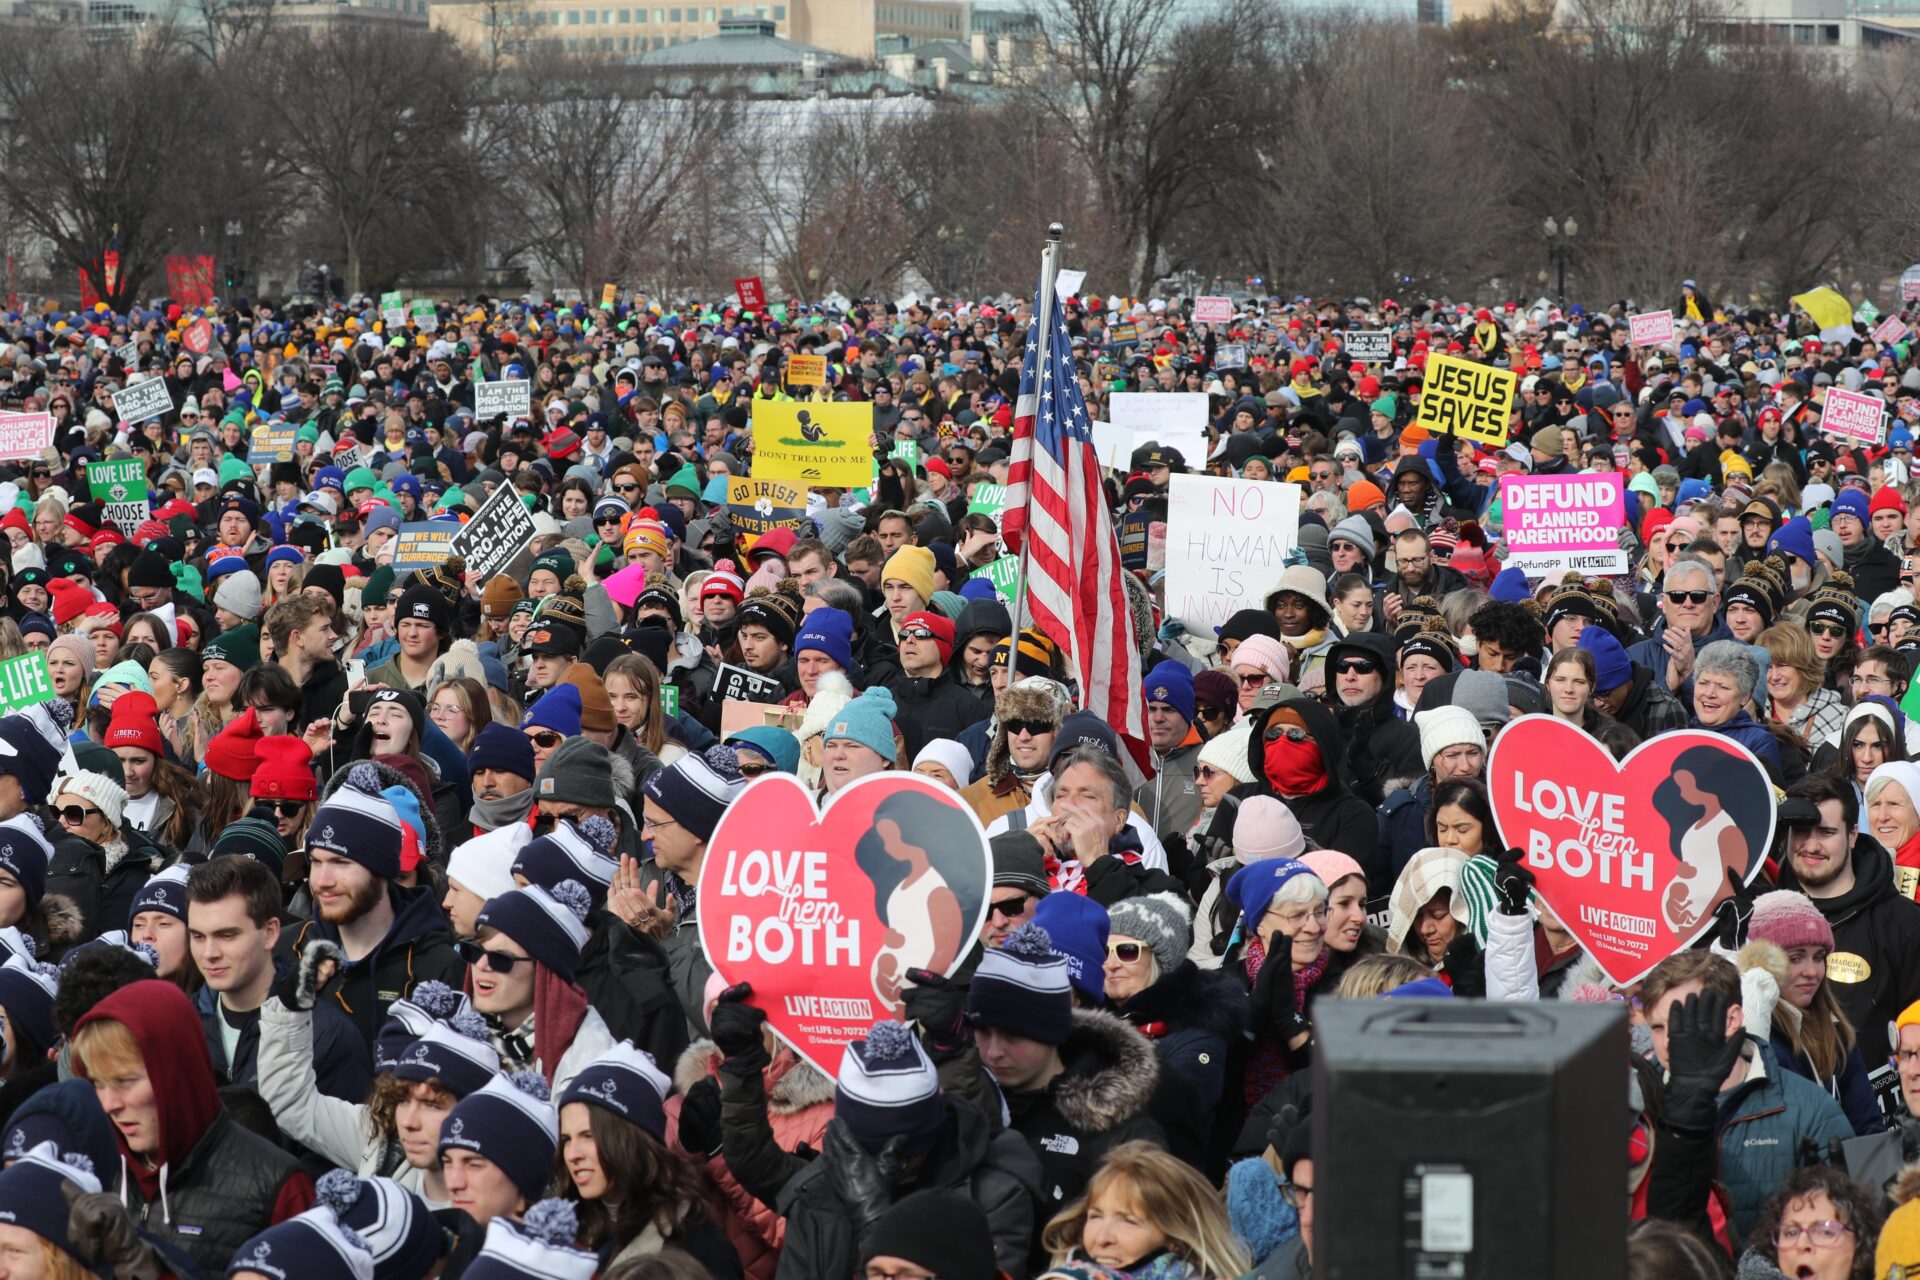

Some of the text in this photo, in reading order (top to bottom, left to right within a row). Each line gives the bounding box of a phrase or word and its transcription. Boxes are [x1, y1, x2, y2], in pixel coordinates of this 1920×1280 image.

[1633, 316, 1670, 330] DEFUND
[1347, 343, 1389, 351] PRO-LIFE
[1355, 336, 1367, 344] AM
[1370, 336, 1387, 344] THE
[125, 391, 141, 403] AM
[143, 382, 161, 395] THE
[507, 386, 526, 394] THE
[1427, 363, 1508, 407] JESUS
[116, 390, 168, 412] PRO-LIFE
[121, 400, 170, 420] GENERATION
[478, 393, 529, 407] PRO-LIFE
[478, 404, 528, 414] GENERATION
[1828, 394, 1880, 419] DEFUND
[1422, 394, 1505, 438] SAVES
[1827, 408, 1877, 429] PLANNED
[1824, 418, 1875, 437] PARENTHOOD
[760, 450, 867, 464] DONT TREAD ON ME
[893, 441, 914, 458] LIFE
[90, 462, 143, 485] LOVE LIFE
[733, 482, 798, 505] GO IRISH
[1212, 486, 1264, 521] NO
[1506, 481, 1616, 510] DEFUND
[101, 503, 144, 522] CHOOSE
[731, 514, 759, 531] SAVE
[1522, 511, 1600, 528] PLANNED
[460, 494, 515, 556] I AM THE
[1507, 526, 1618, 545] PARENTHOOD
[397, 542, 418, 552] NOT
[415, 531, 451, 542] WE WILL
[464, 501, 526, 573] PRO-LIFE
[478, 518, 532, 579] ENERATION
[1187, 535, 1288, 567] HUMAN
[1569, 556, 1588, 574] LIVE
[1589, 555, 1617, 572] ACTION
[1207, 567, 1245, 597] IS
[994, 651, 1008, 664] N
[5, 655, 50, 702] LIFE
[113, 729, 142, 737] LIBERTY
[1514, 770, 1625, 835] LOVE
[1558, 814, 1642, 858] them
[1527, 828, 1654, 892] BOTH
[720, 850, 828, 899] LOVE
[760, 882, 845, 924] them
[1580, 903, 1656, 935] LIVE ACTION
[726, 914, 861, 967] BOTH
[1588, 929, 1603, 938] Text
[1603, 932, 1617, 944] LIFE
[1626, 938, 1649, 951] 70723
[1831, 958, 1853, 967] MADE
[784, 995, 872, 1018] LIVE ACTION
[798, 1024, 814, 1034] Text
[814, 1025, 832, 1035] LIFE
[842, 1026, 868, 1037] 70723
[1749, 1138, 1779, 1146] Columbia
